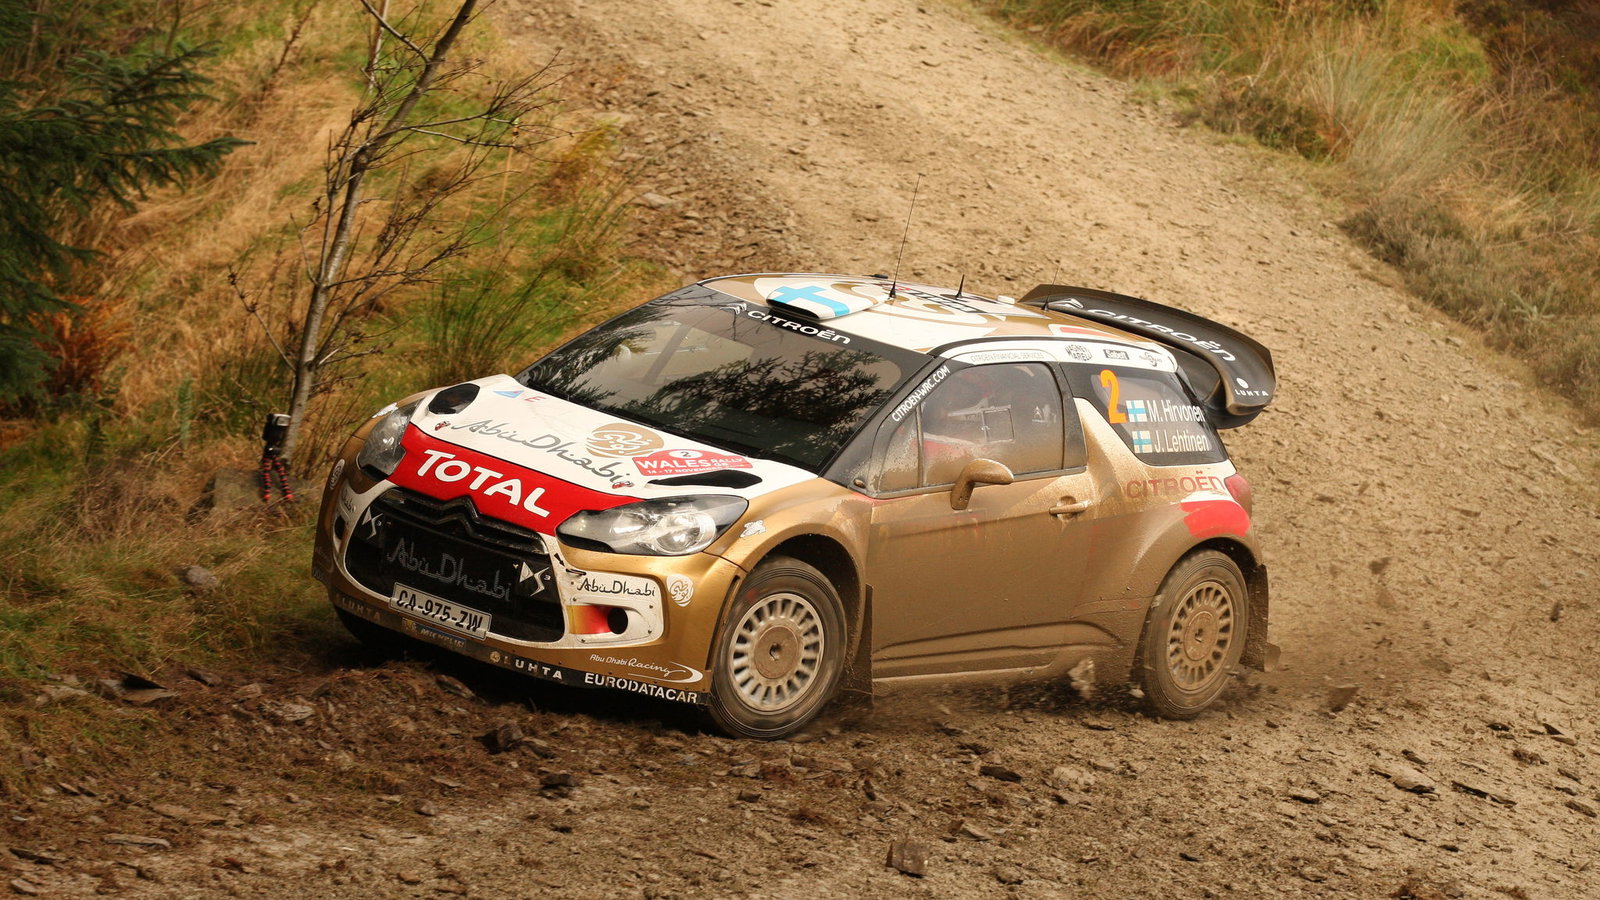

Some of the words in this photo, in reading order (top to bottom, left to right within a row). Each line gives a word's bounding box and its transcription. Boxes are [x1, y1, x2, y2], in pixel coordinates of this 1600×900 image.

[891, 364, 950, 422] CITROEN-WRC.COM
[1100, 369, 1127, 424] 2
[1234, 388, 1269, 397] LUHTA
[1147, 400, 1163, 423] M.
[1163, 400, 1206, 423] Hirvonen
[1154, 430, 1164, 454] J.
[1164, 430, 1210, 452] Lehtinen
[636, 460, 710, 469] WALES
[416, 449, 551, 519] TOTAL
[396, 589, 483, 632] CA-975-ZW
[503, 655, 563, 681] LUHTA
[590, 653, 606, 662] Abu
[606, 656, 628, 666] Dhabi
[627, 658, 686, 678] Racing
[584, 672, 698, 704] EURODATACAR
